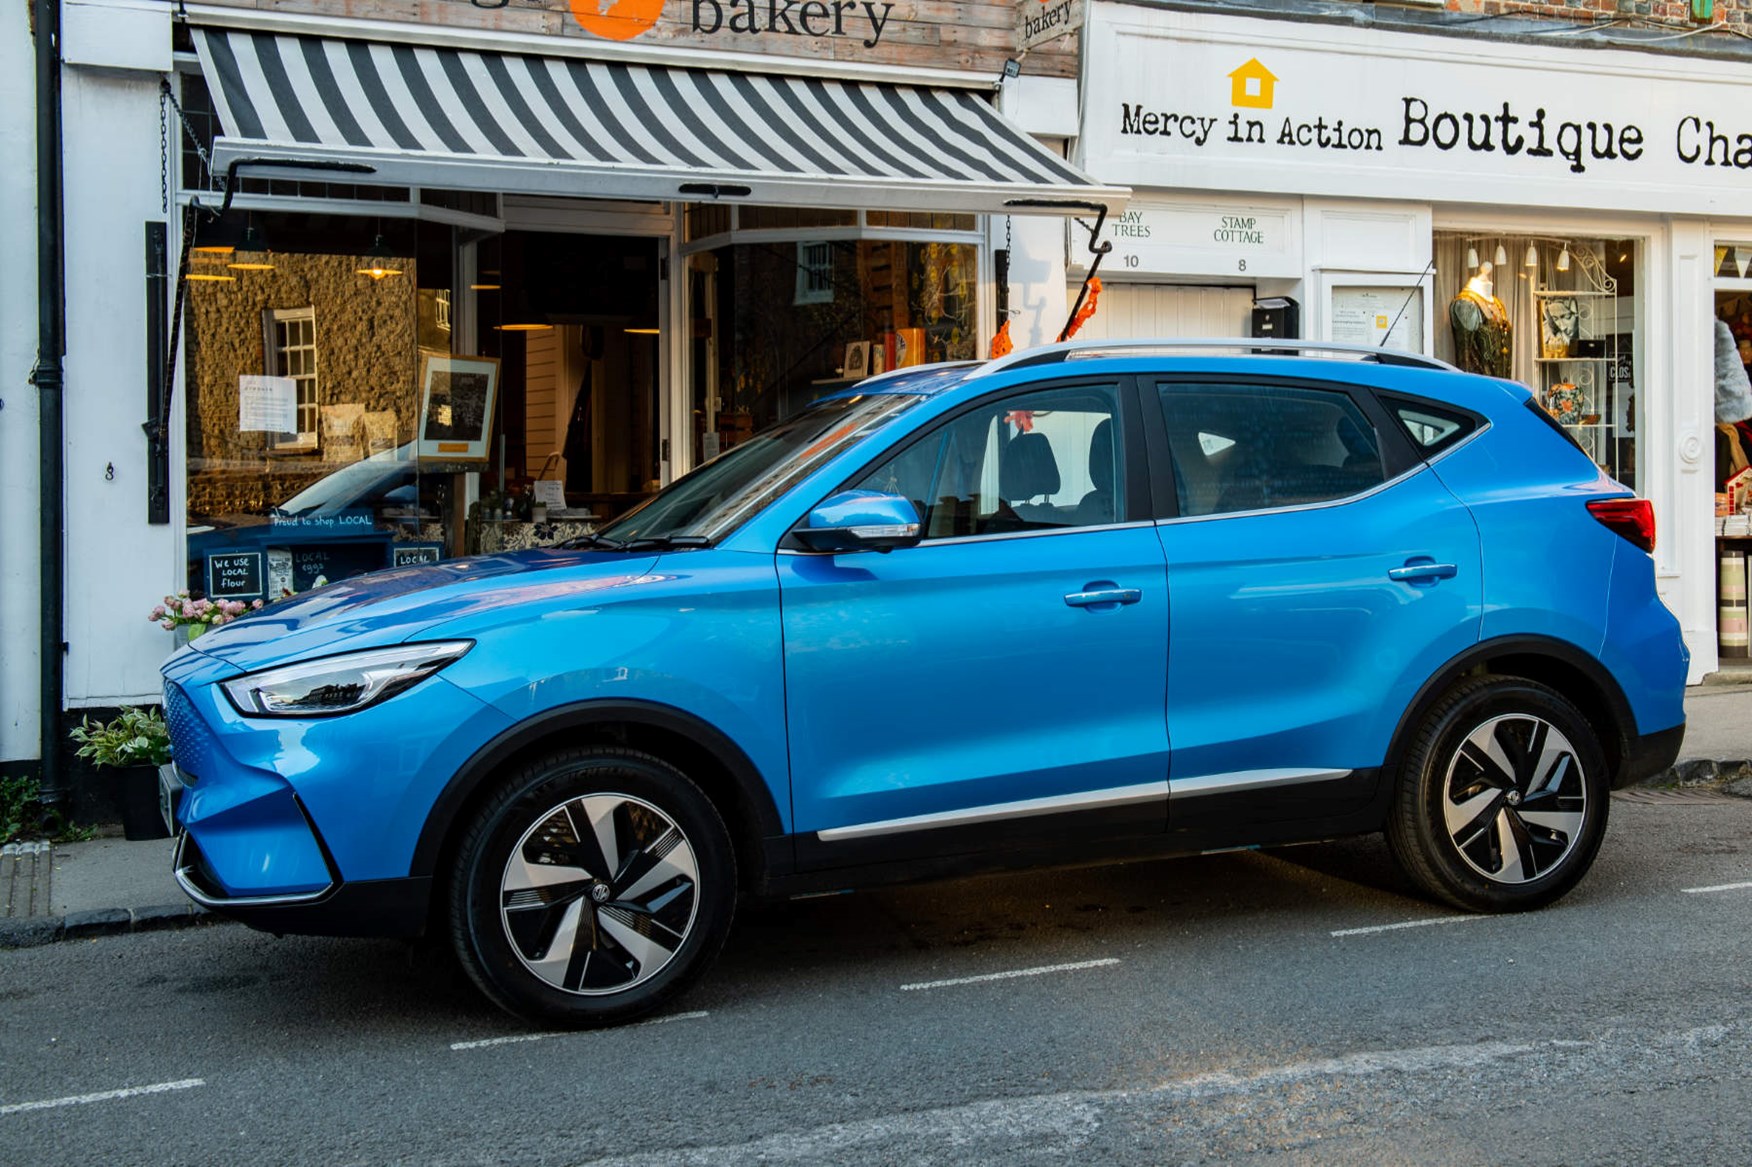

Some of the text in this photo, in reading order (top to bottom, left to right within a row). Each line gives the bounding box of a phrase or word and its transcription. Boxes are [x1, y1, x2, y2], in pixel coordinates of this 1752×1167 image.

[692, 0, 895, 48] bakery
[1025, 0, 1072, 39] bakery
[1121, 103, 1218, 147] Mercy
[1226, 112, 1266, 144] in
[1276, 116, 1384, 151] Action
[1398, 97, 1643, 173] Boutique
[1119, 212, 1142, 224] BAY
[1221, 216, 1257, 230] STAMP
[1112, 224, 1151, 238] TREES
[1213, 229, 1264, 244] COTTAGE
[1123, 255, 1139, 268] 10
[1238, 259, 1247, 272] 8
[274, 514, 373, 528] Proud to shop LOCAL
[295, 551, 330, 563] LOCAL
[214, 559, 230, 569] We
[222, 568, 249, 576] LOCAL
[221, 578, 246, 589] flour
